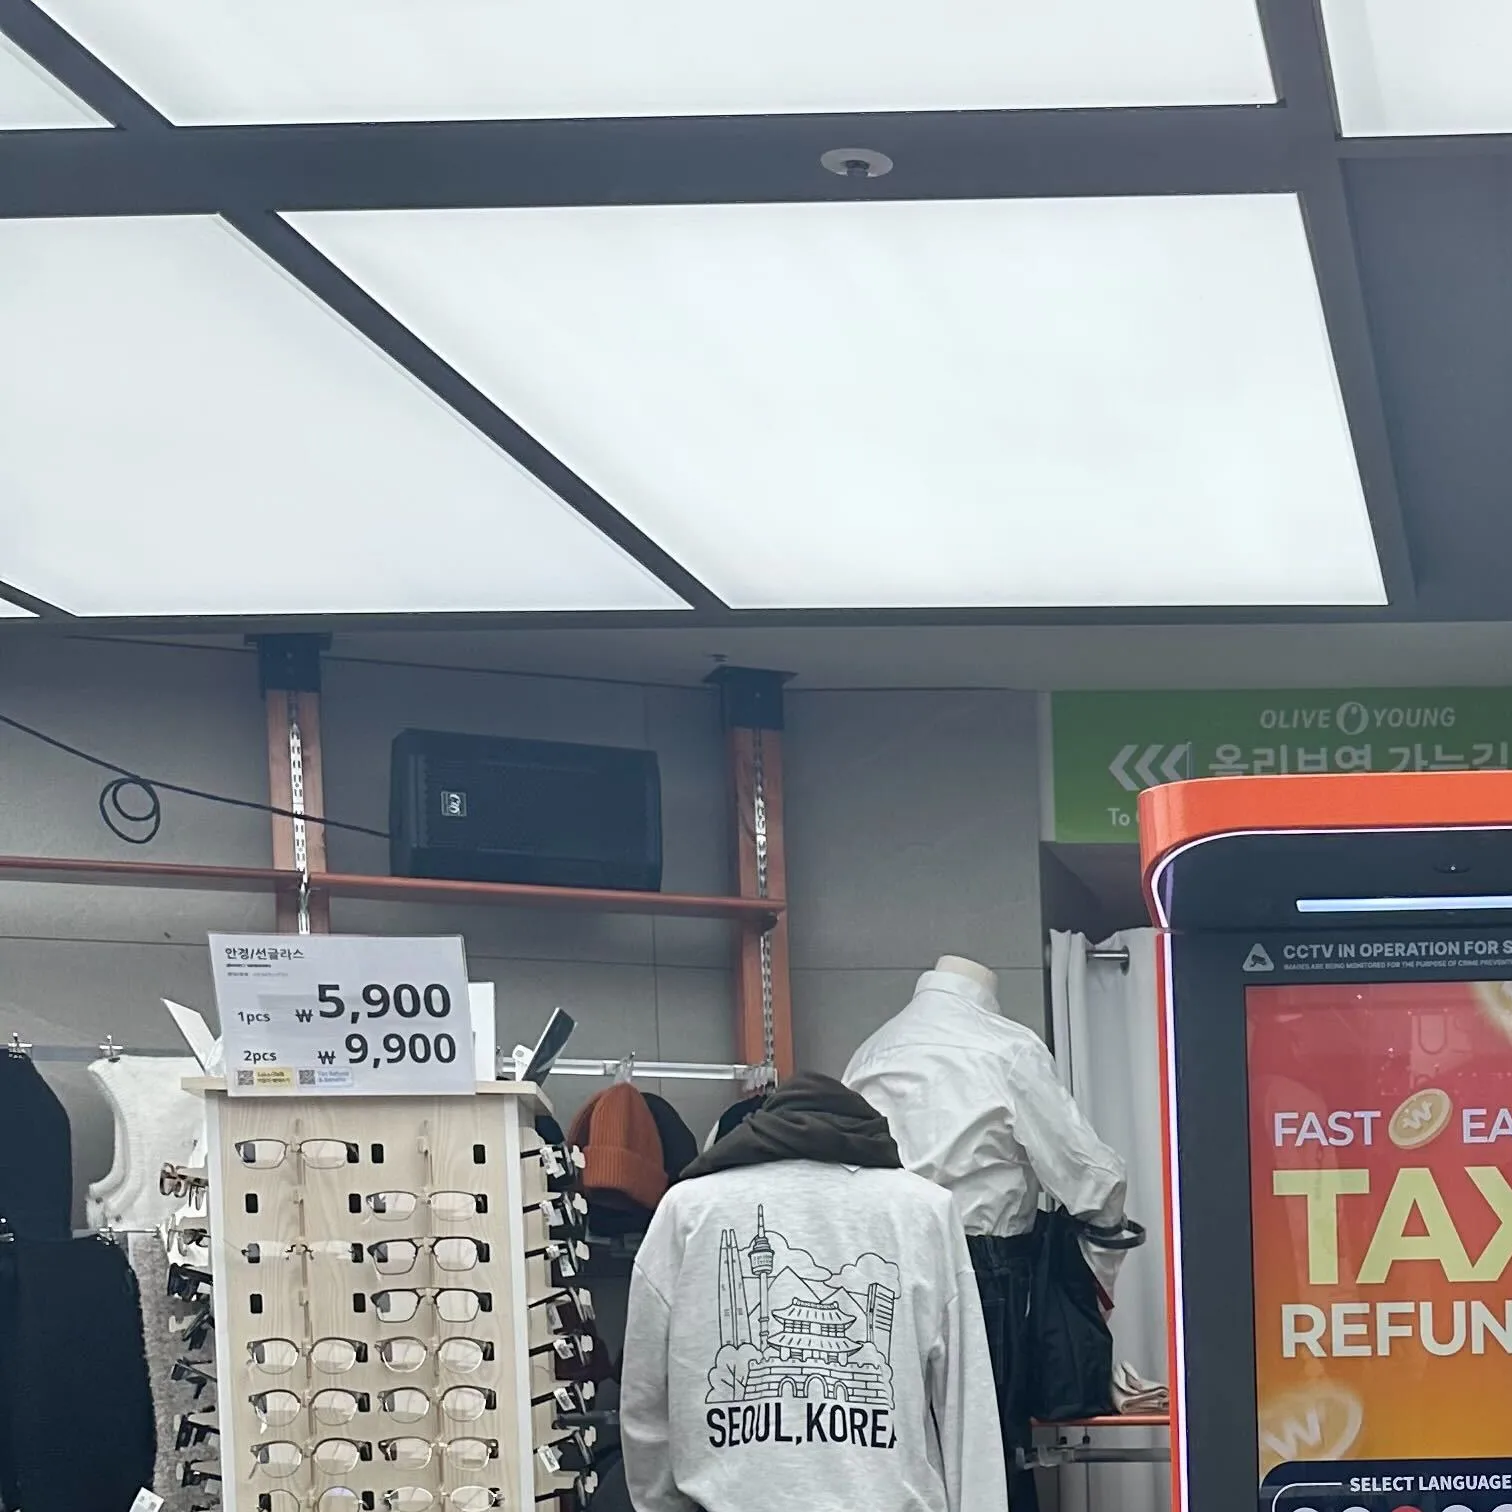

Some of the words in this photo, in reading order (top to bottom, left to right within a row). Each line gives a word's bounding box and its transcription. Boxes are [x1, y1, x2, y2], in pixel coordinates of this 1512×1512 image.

[1260, 708, 1331, 730] OLIVE
[1372, 706, 1456, 728] YOUNG
[1107, 807, 1130, 827] To
[1283, 943, 1334, 959] CCTV
[1338, 943, 1355, 958] IN
[1359, 941, 1460, 957] OPERATION
[1464, 940, 1499, 955] FOR
[237, 1011, 271, 1025] 1pcs
[243, 1050, 277, 1064] 2pcs
[1273, 1110, 1382, 1147] FAST
[1350, 1476, 1415, 1492] SELECT
[1418, 1475, 1512, 1491] LANGUAGE
